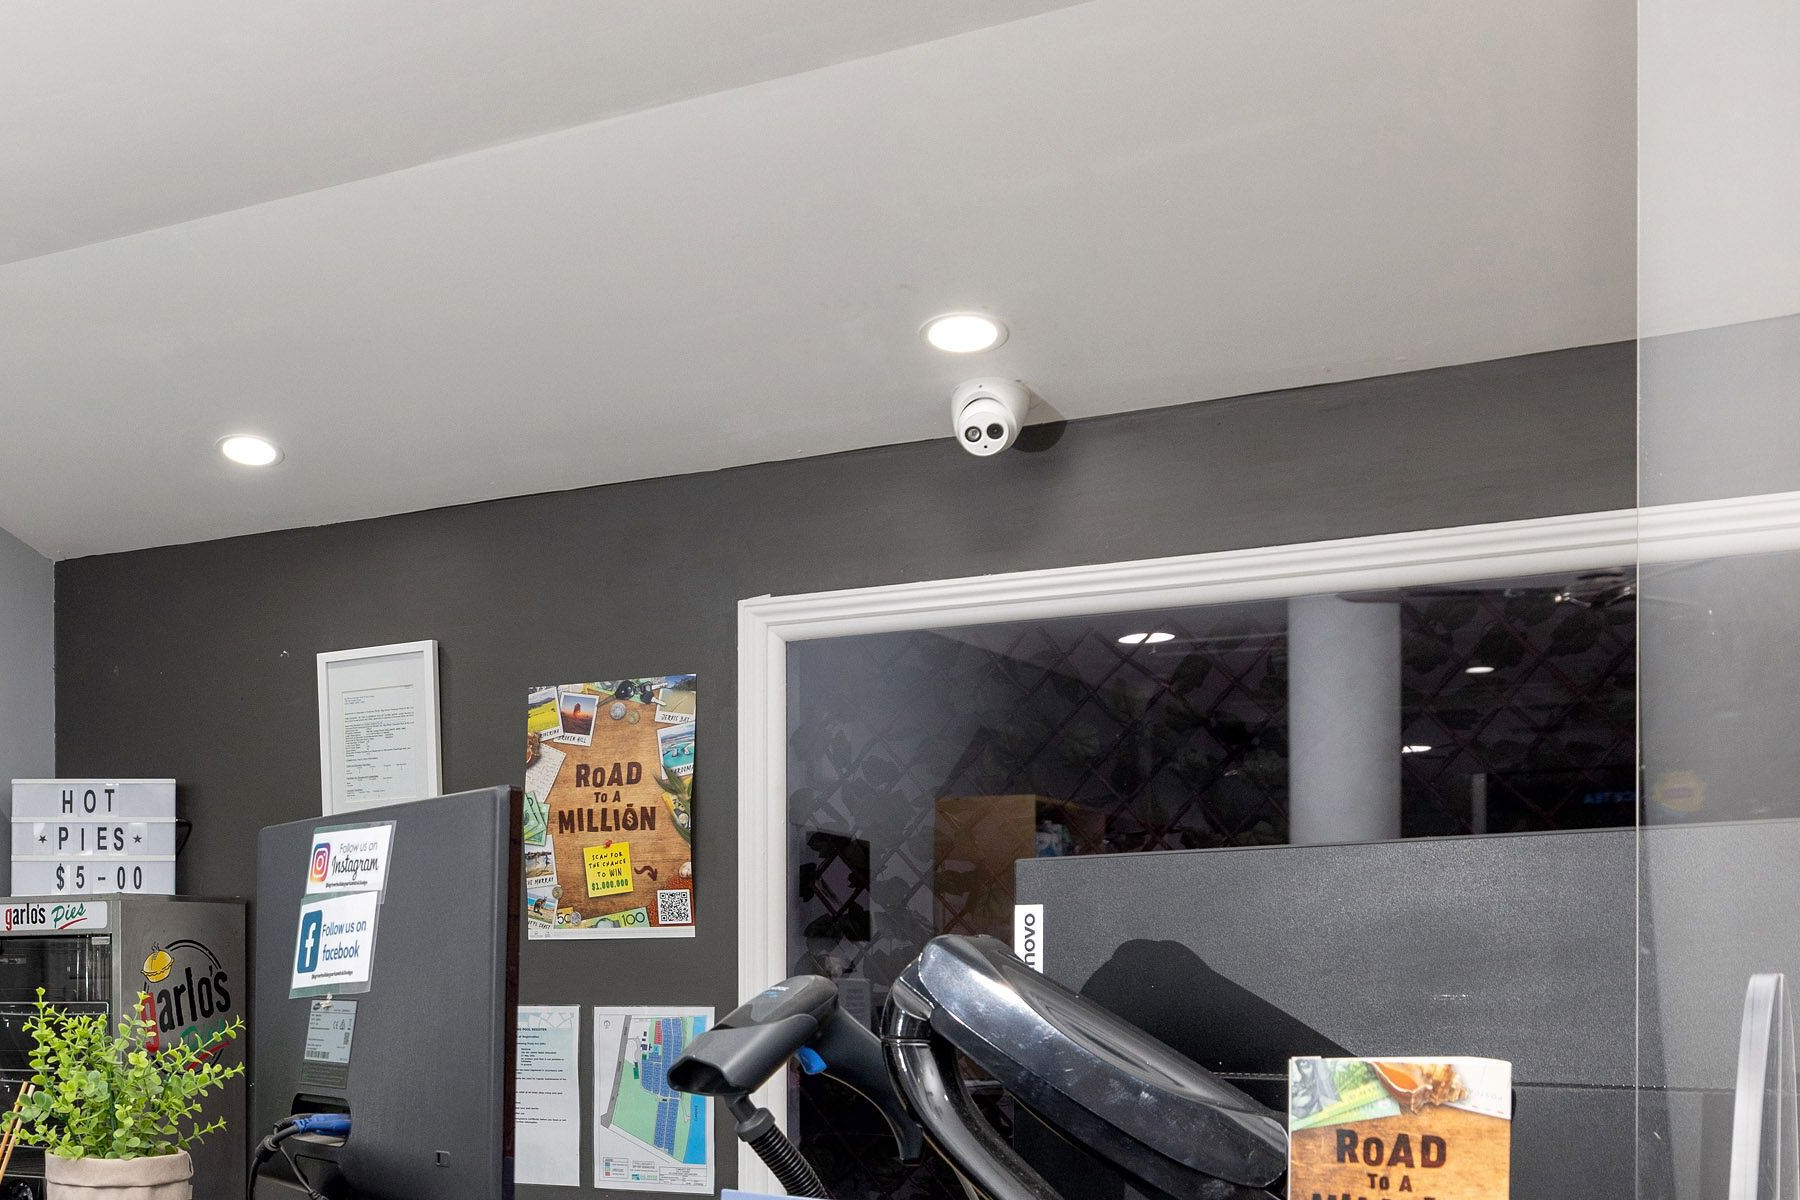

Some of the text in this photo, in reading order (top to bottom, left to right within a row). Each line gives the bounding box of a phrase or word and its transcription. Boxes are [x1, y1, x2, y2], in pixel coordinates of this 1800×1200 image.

[62, 788, 115, 813] HOT
[613, 791, 621, 803] A
[558, 803, 656, 834] MILLION
[58, 827, 124, 850] PIES
[340, 842, 378, 854] Follow us on
[332, 855, 378, 880] Instagram
[602, 858, 626, 867] CHANCE
[609, 868, 622, 877] WIN
[5, 903, 87, 931] garlo's Pies
[621, 912, 645, 927] 100
[322, 921, 366, 936] Follow us on
[322, 939, 360, 961] facebook
[1399, 1174, 1413, 1192] A
